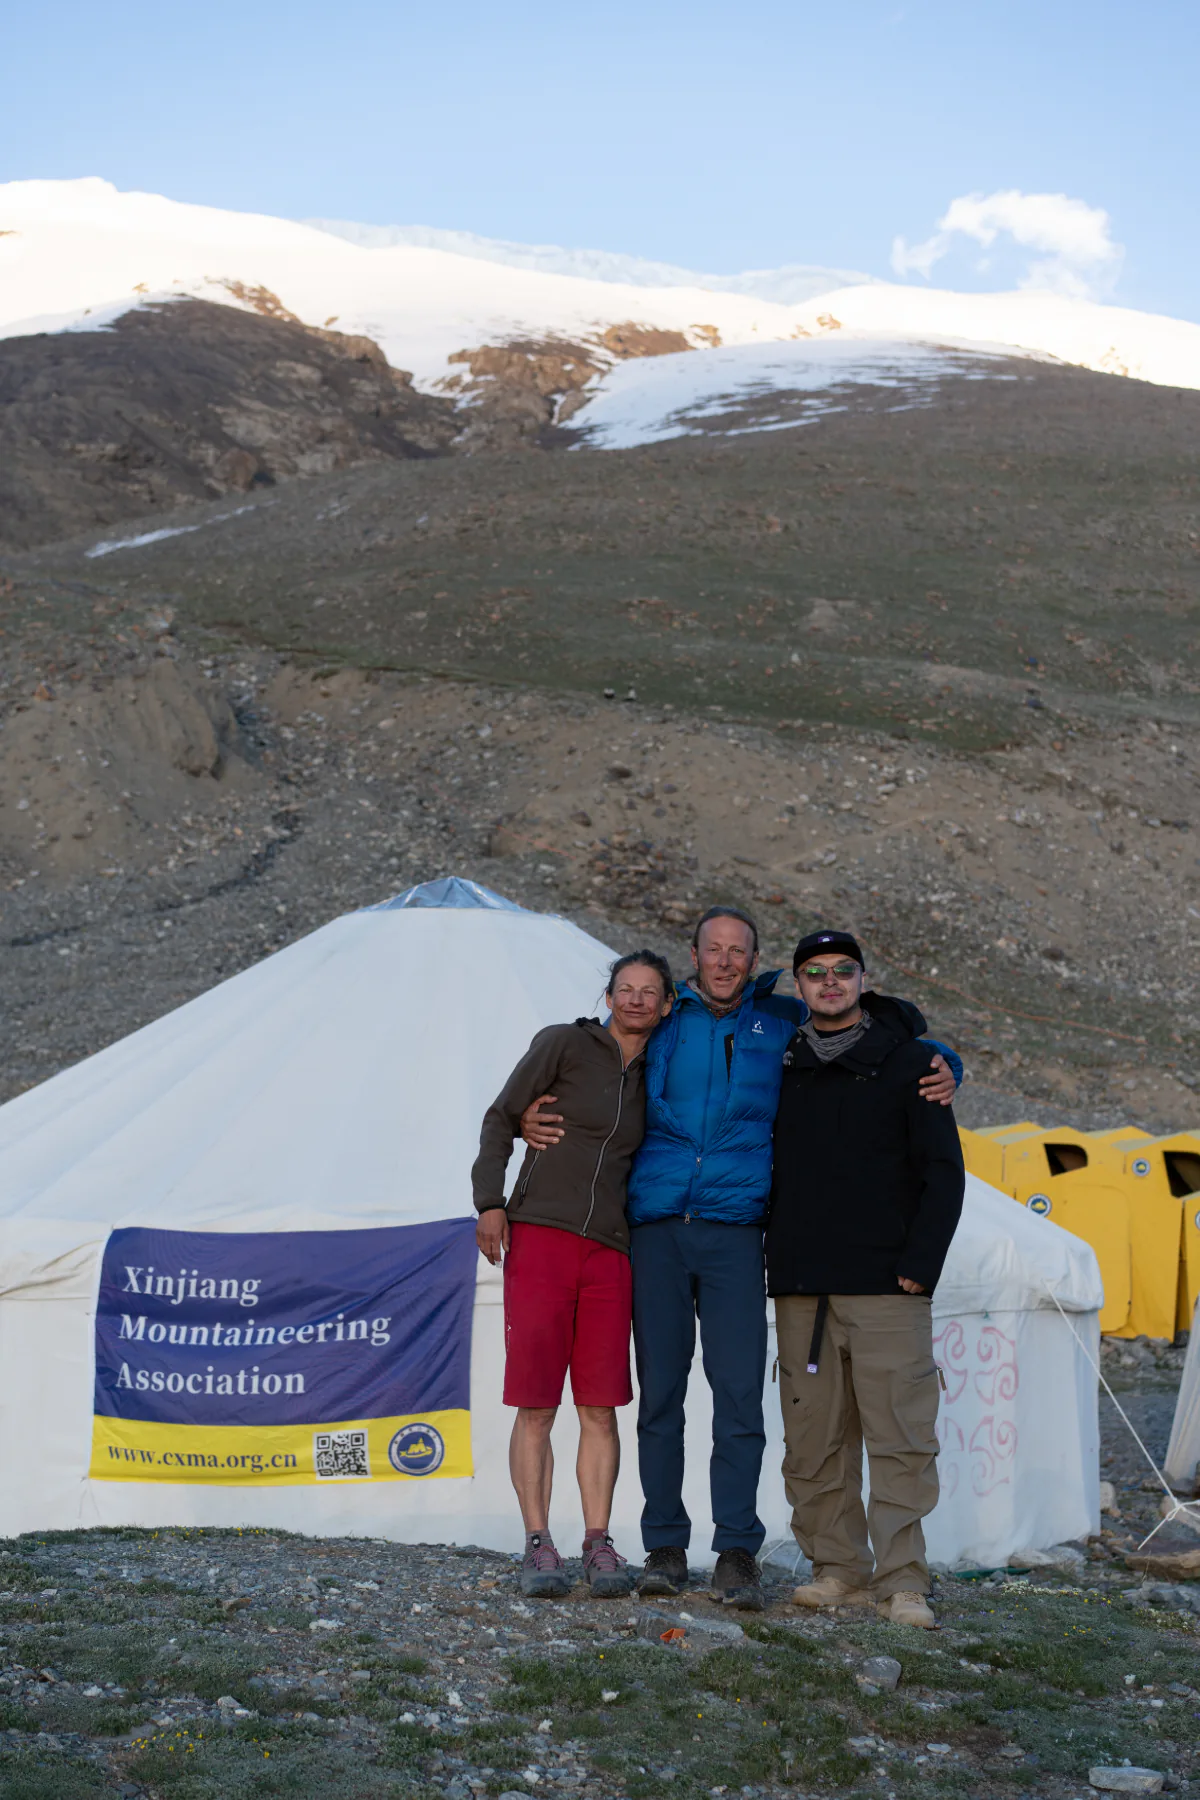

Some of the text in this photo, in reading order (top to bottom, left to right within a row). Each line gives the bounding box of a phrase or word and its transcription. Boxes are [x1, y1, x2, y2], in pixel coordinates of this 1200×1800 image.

[122, 1266, 262, 1307] Xinjiang
[119, 1313, 392, 1346] Mountaineering
[115, 1362, 306, 1395] Association
[107, 1445, 298, 1473] www.cxma.org.cn
